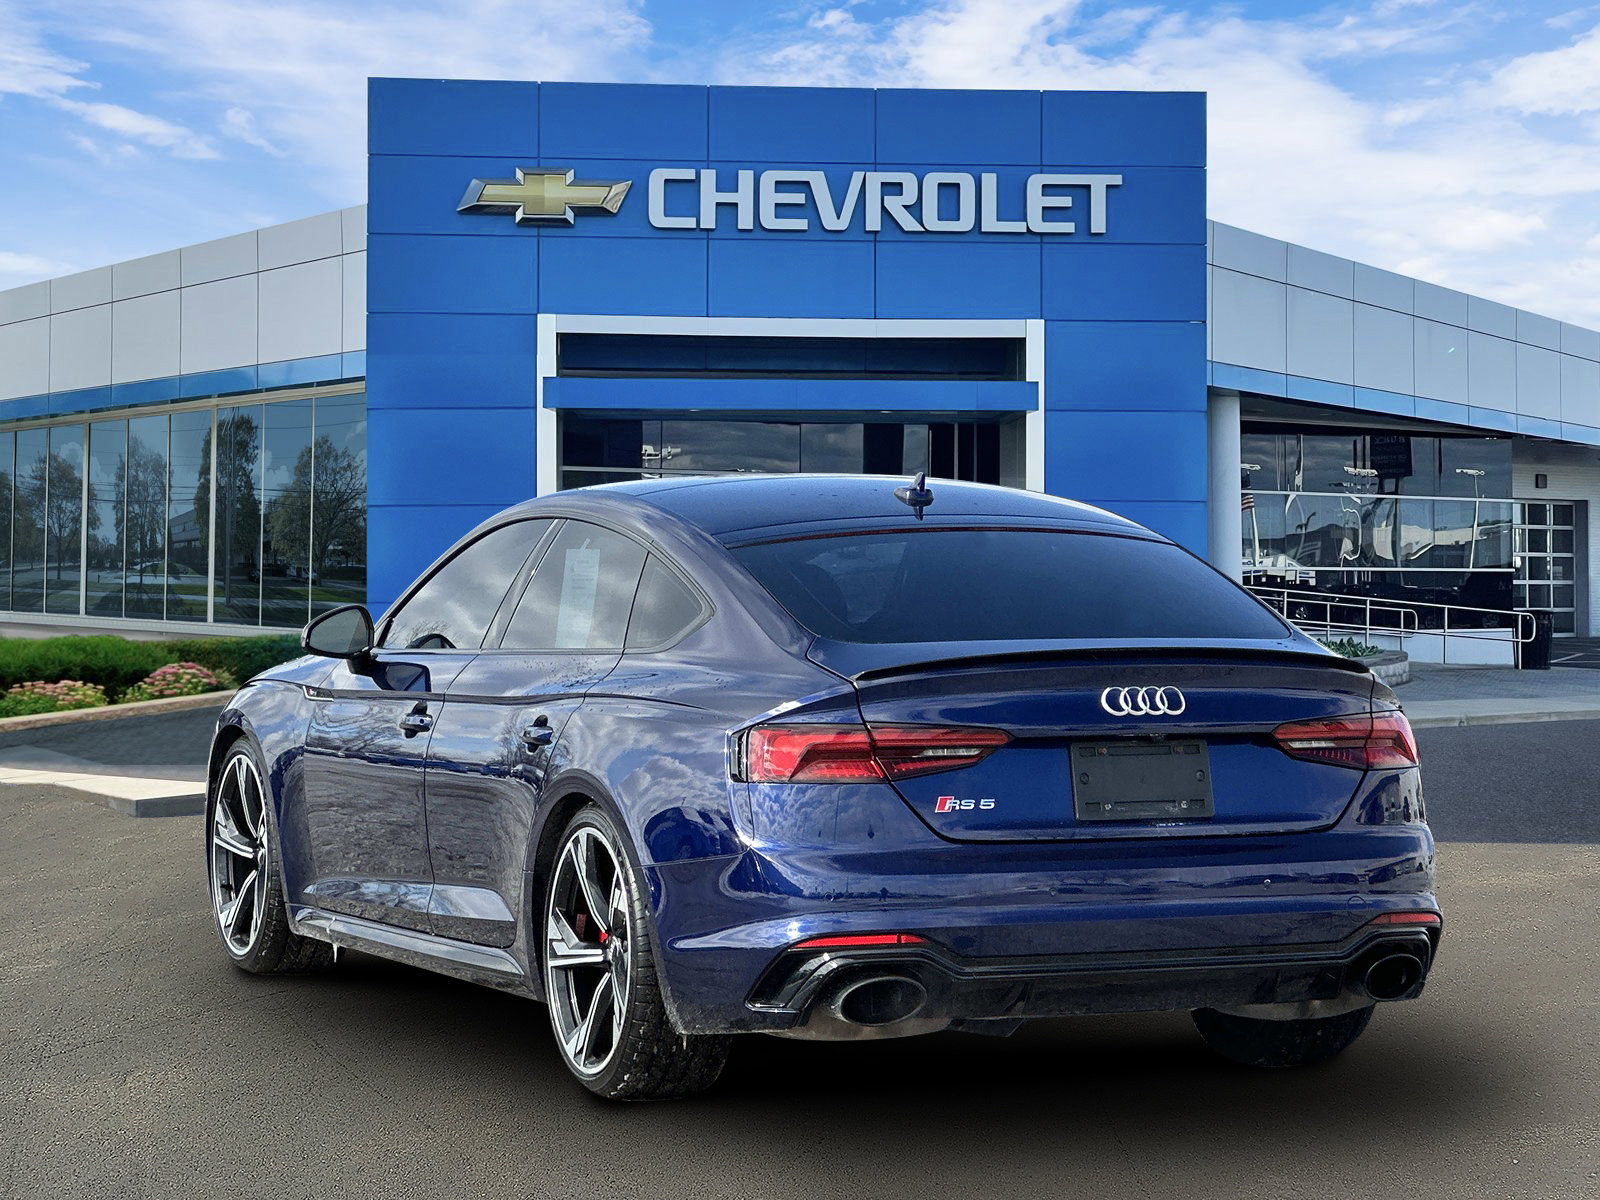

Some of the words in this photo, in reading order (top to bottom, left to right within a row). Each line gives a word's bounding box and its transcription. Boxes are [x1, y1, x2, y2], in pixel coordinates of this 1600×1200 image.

[648, 167, 1123, 234] CHEVROLET
[941, 798, 976, 811] RS
[979, 798, 996, 810] 5
